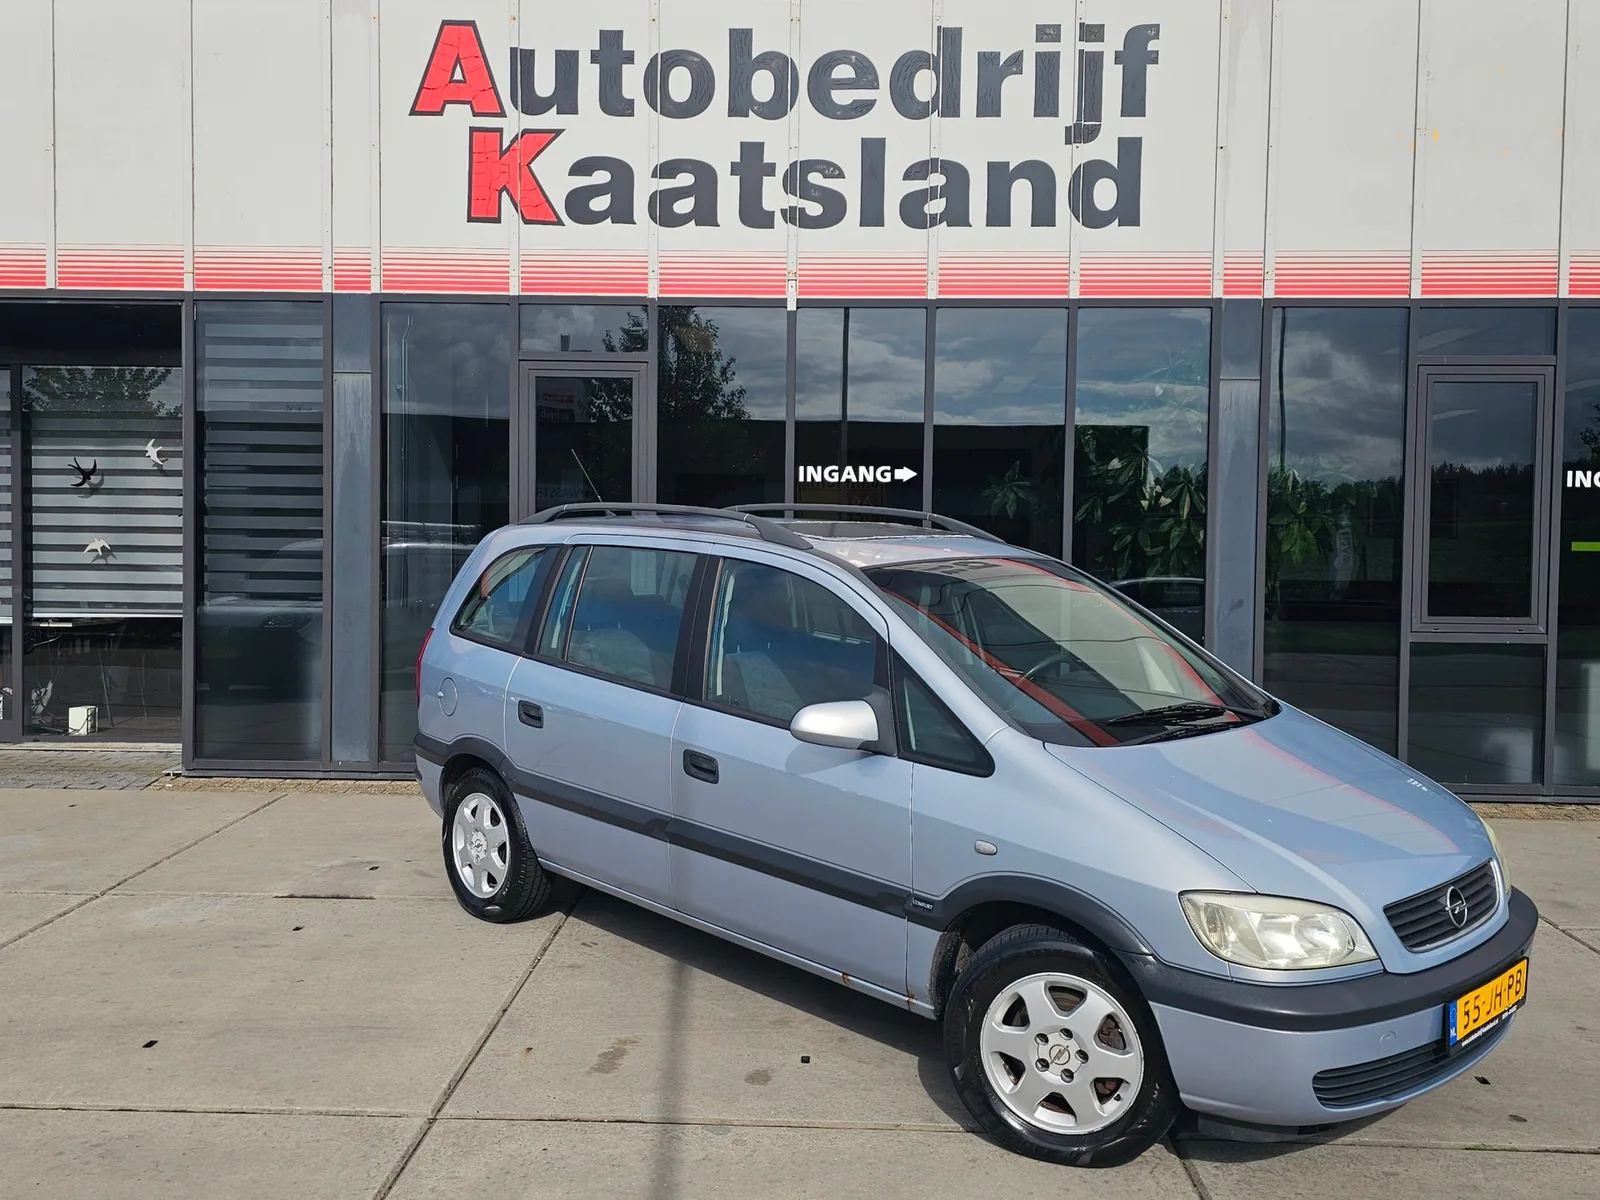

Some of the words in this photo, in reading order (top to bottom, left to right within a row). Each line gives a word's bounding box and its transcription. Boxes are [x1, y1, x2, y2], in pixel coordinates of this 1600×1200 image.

[409, 19, 1160, 145] Autobedrijf
[467, 126, 1143, 230] Kaatsland
[798, 465, 892, 482] INGANG
[1464, 968, 1523, 1030] 55-JH-PB
